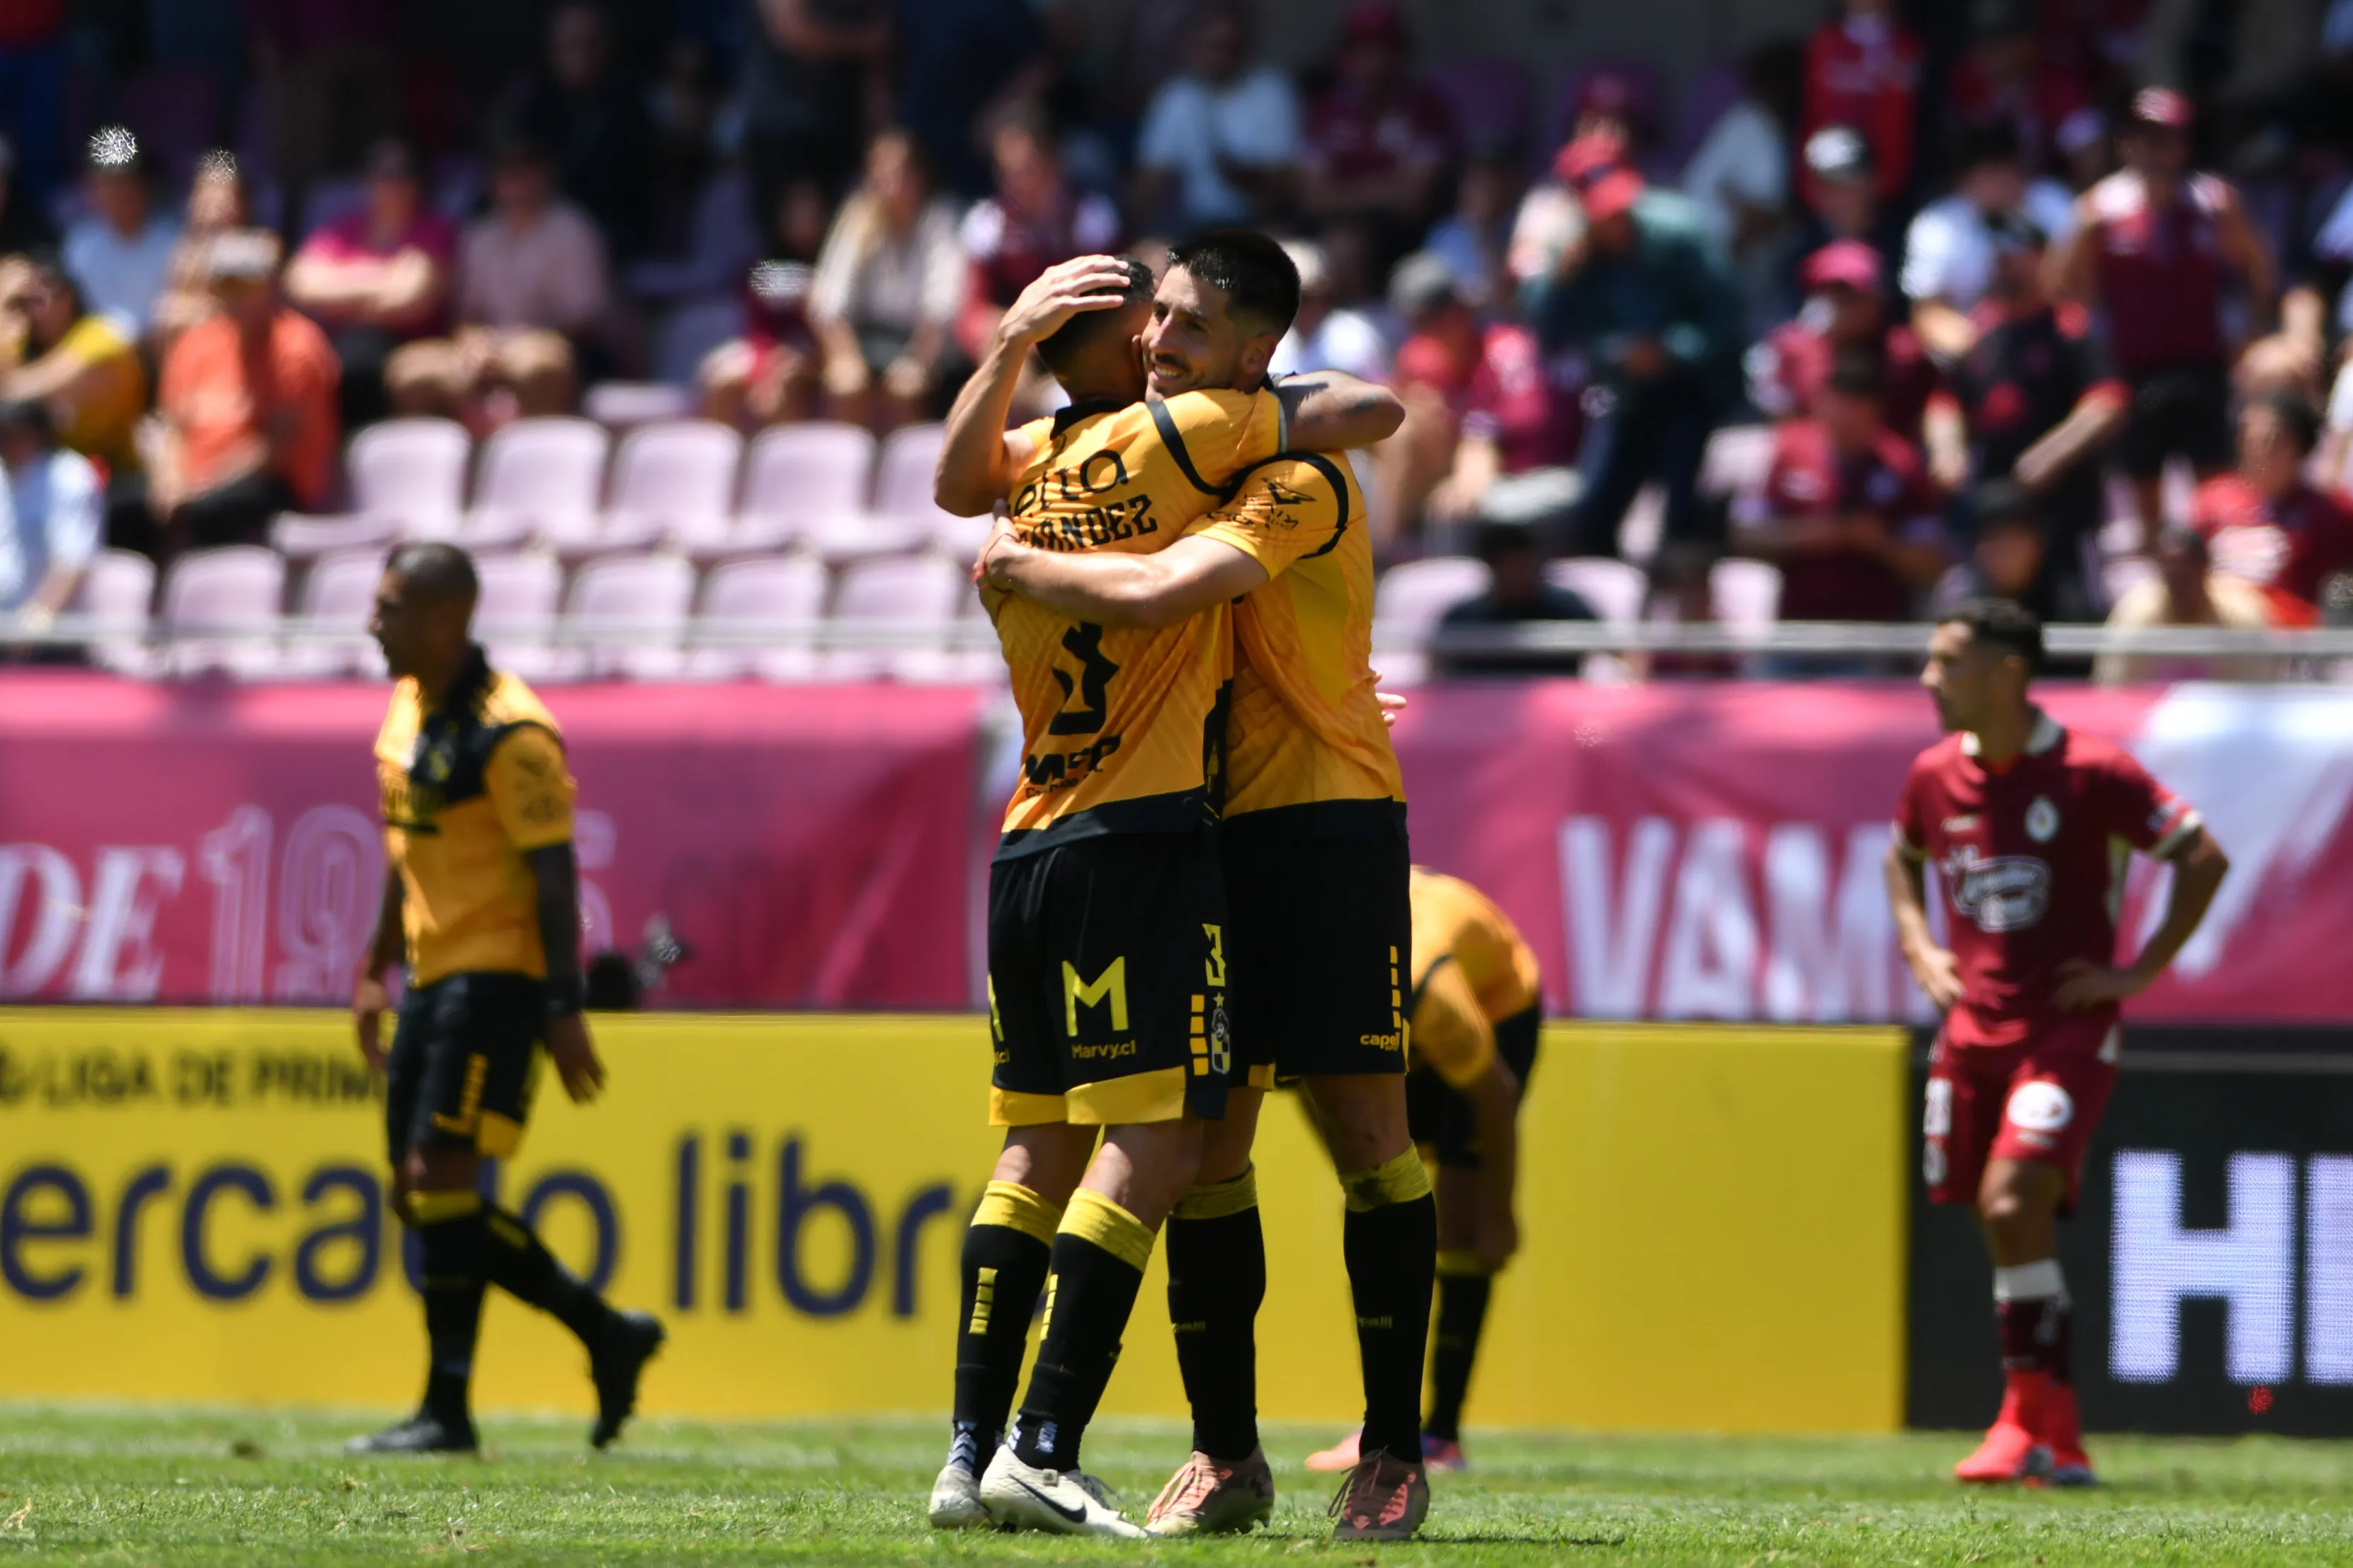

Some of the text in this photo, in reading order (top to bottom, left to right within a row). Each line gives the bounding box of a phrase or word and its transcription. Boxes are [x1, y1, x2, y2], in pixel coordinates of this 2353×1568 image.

[0, 844, 186, 1001] DE
[1202, 924, 1226, 987] 3
[1561, 816, 1951, 1021] VAM
[1062, 956, 1129, 1037] M
[175, 1053, 235, 1104] DE
[1071, 1039, 1136, 1060] Marvy.cl
[0, 1131, 991, 1320] ercao libr
